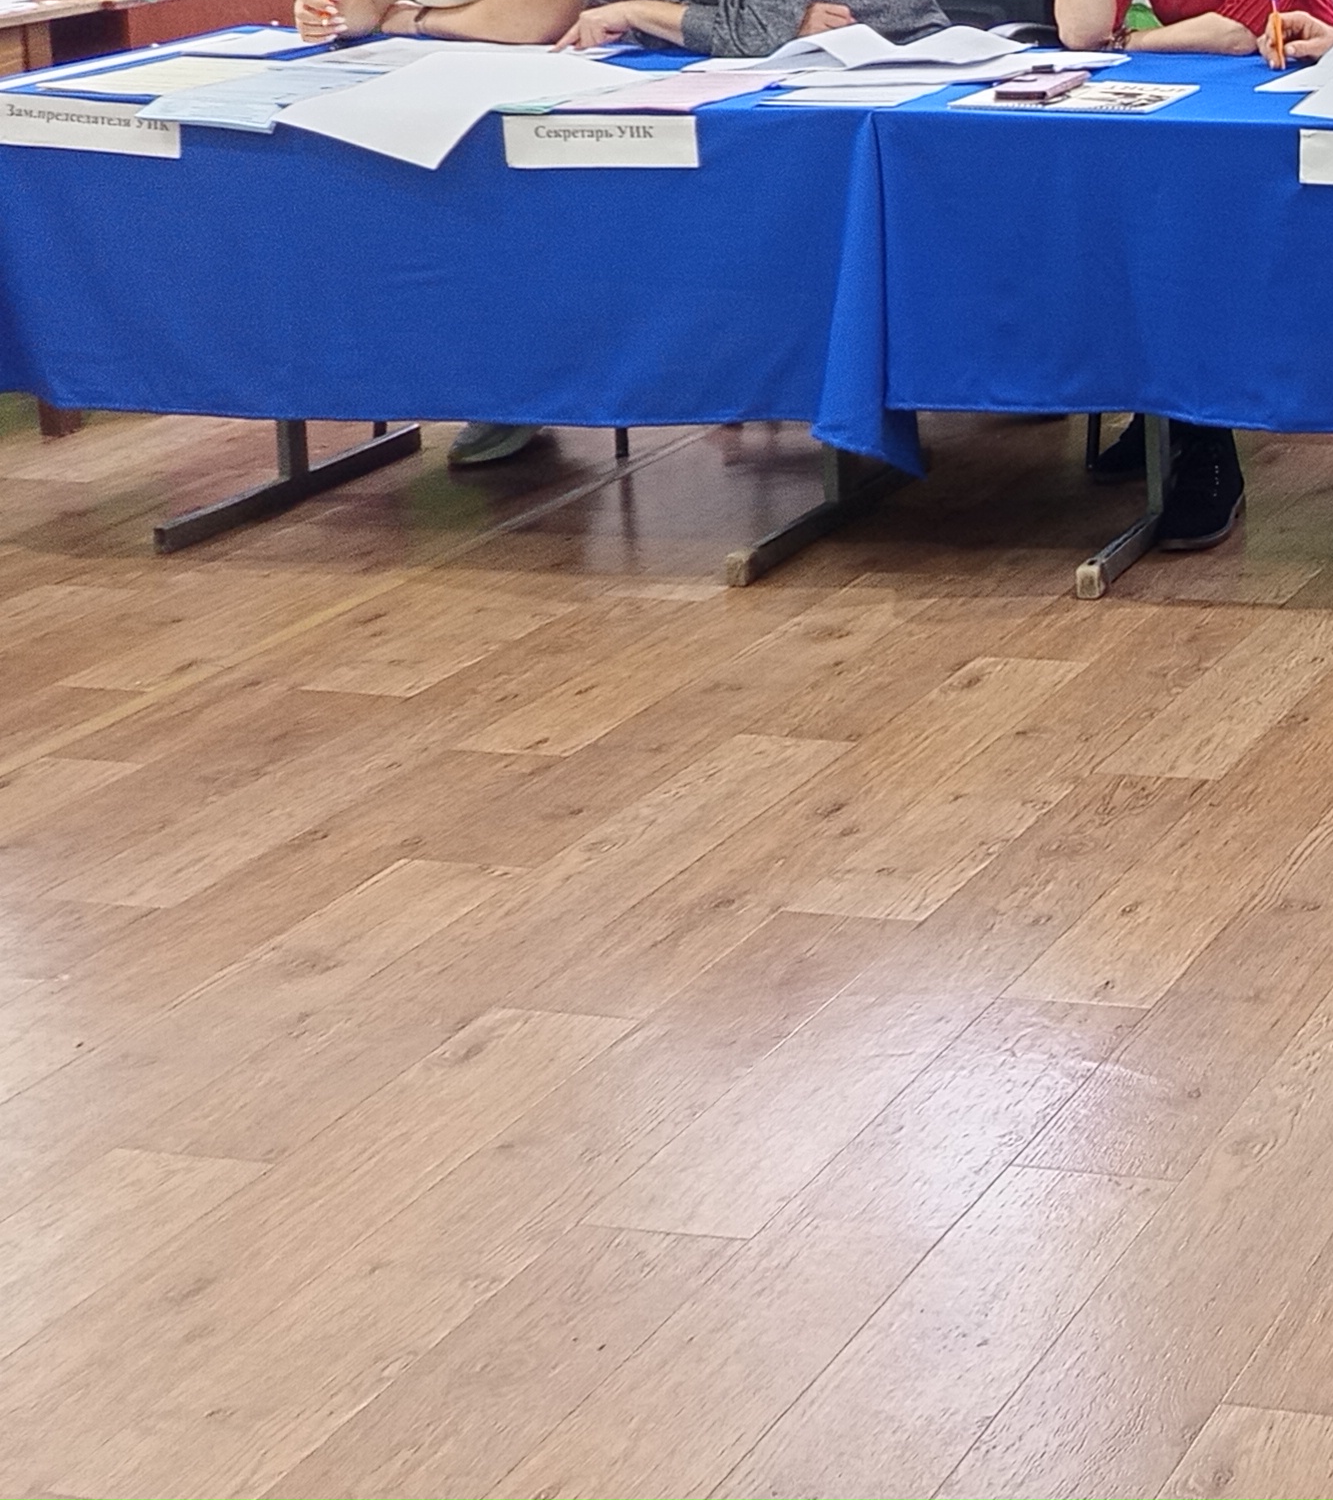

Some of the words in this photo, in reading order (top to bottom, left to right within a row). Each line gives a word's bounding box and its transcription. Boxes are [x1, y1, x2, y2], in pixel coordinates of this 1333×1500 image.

[5, 103, 131, 127] Зам.председателя
[534, 125, 614, 142] Секретарь
[617, 125, 654, 139] УИК
